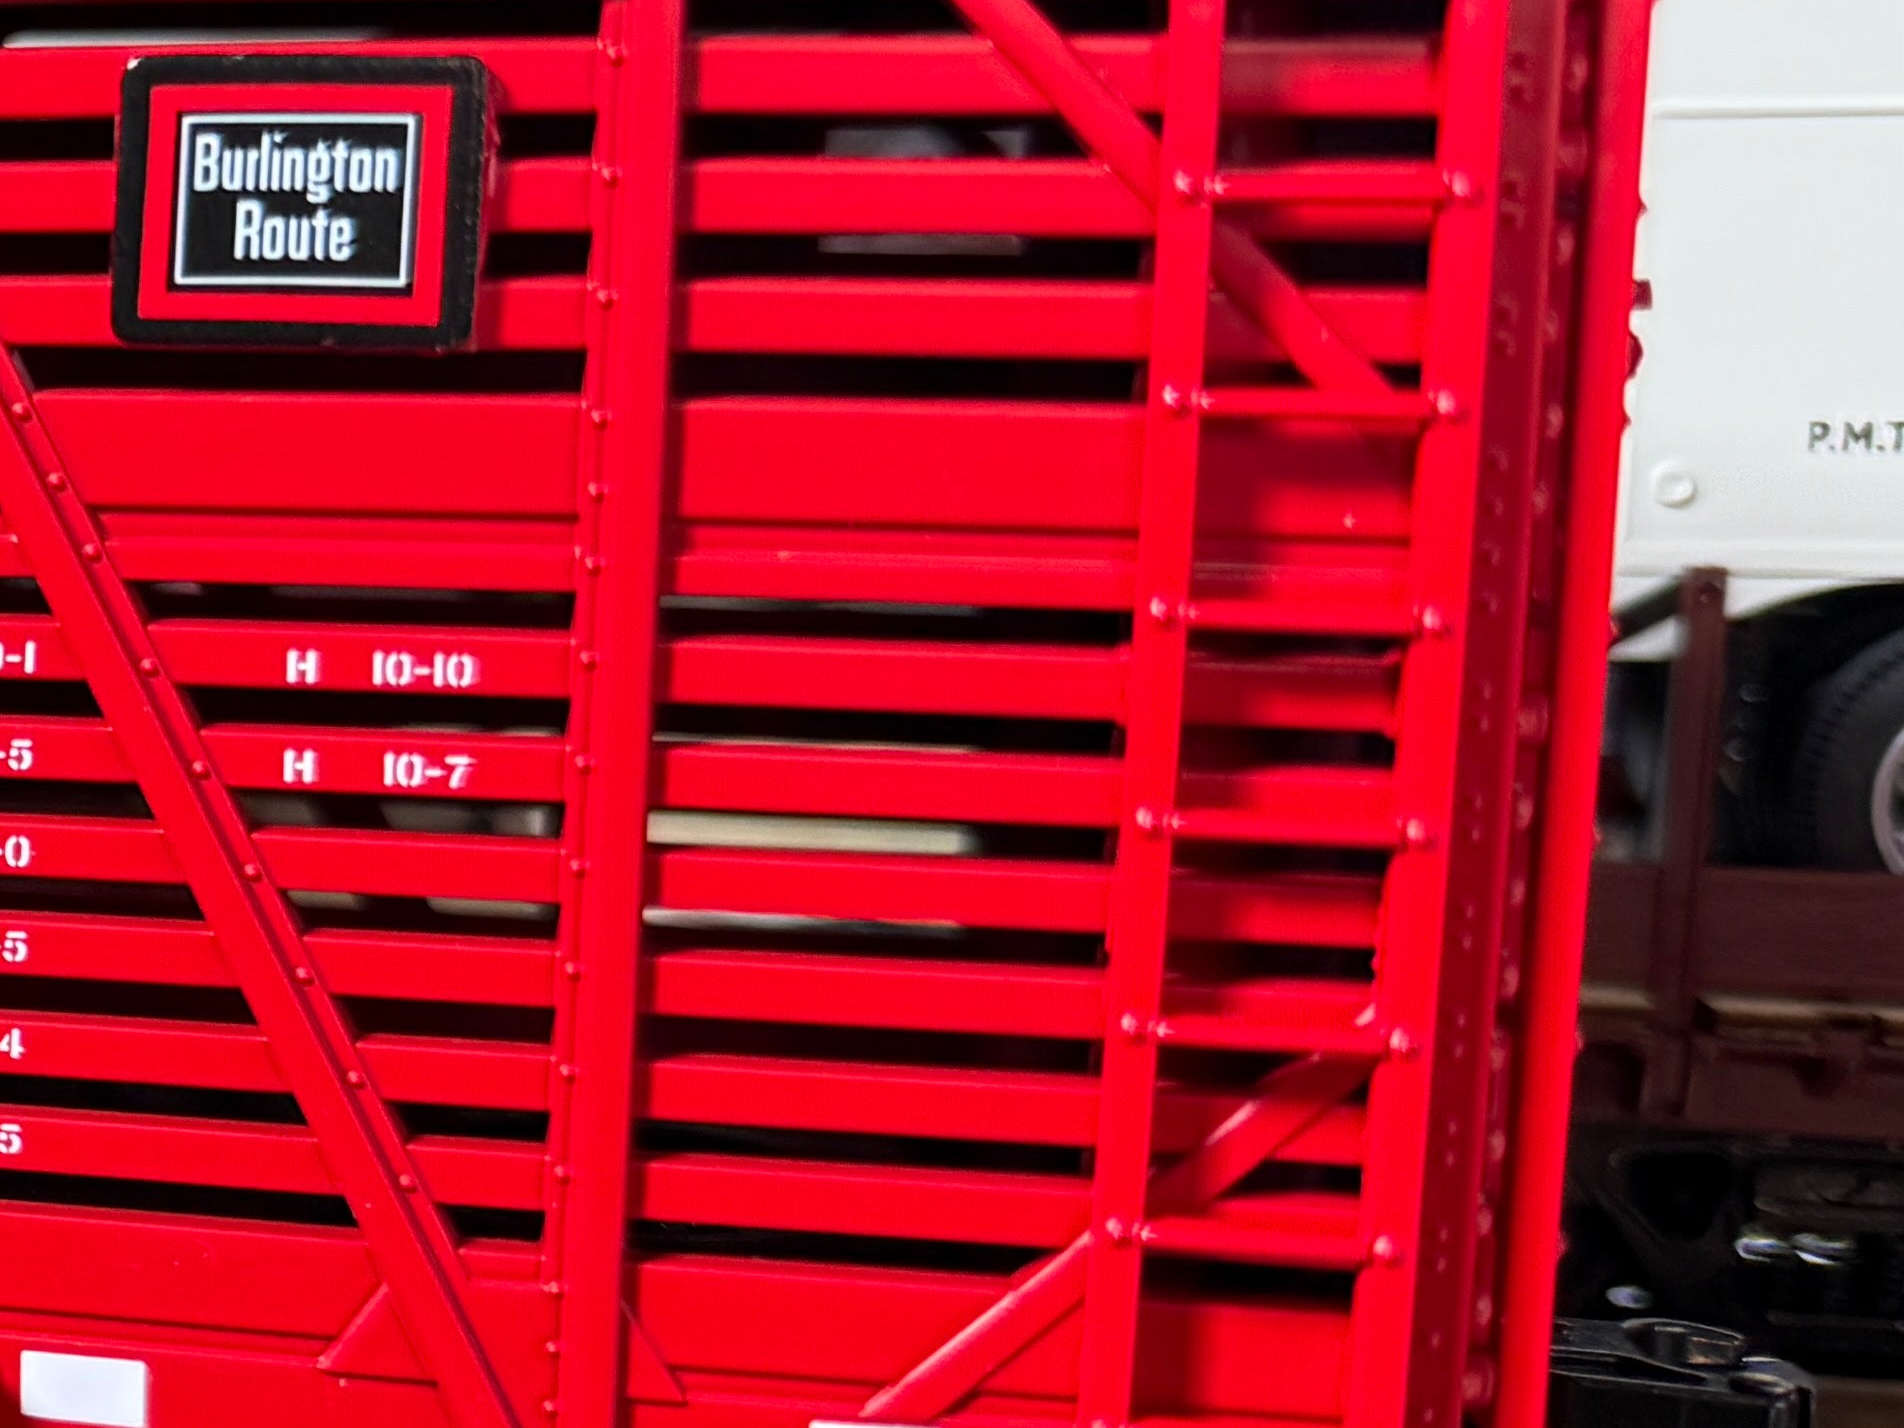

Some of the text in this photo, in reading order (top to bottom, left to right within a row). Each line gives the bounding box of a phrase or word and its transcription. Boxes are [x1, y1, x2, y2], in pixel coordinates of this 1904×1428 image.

[193, 130, 401, 204] Burlington
[234, 198, 358, 262] Route
[285, 648, 479, 689] H 10-10
[282, 748, 477, 789] H 10-7
